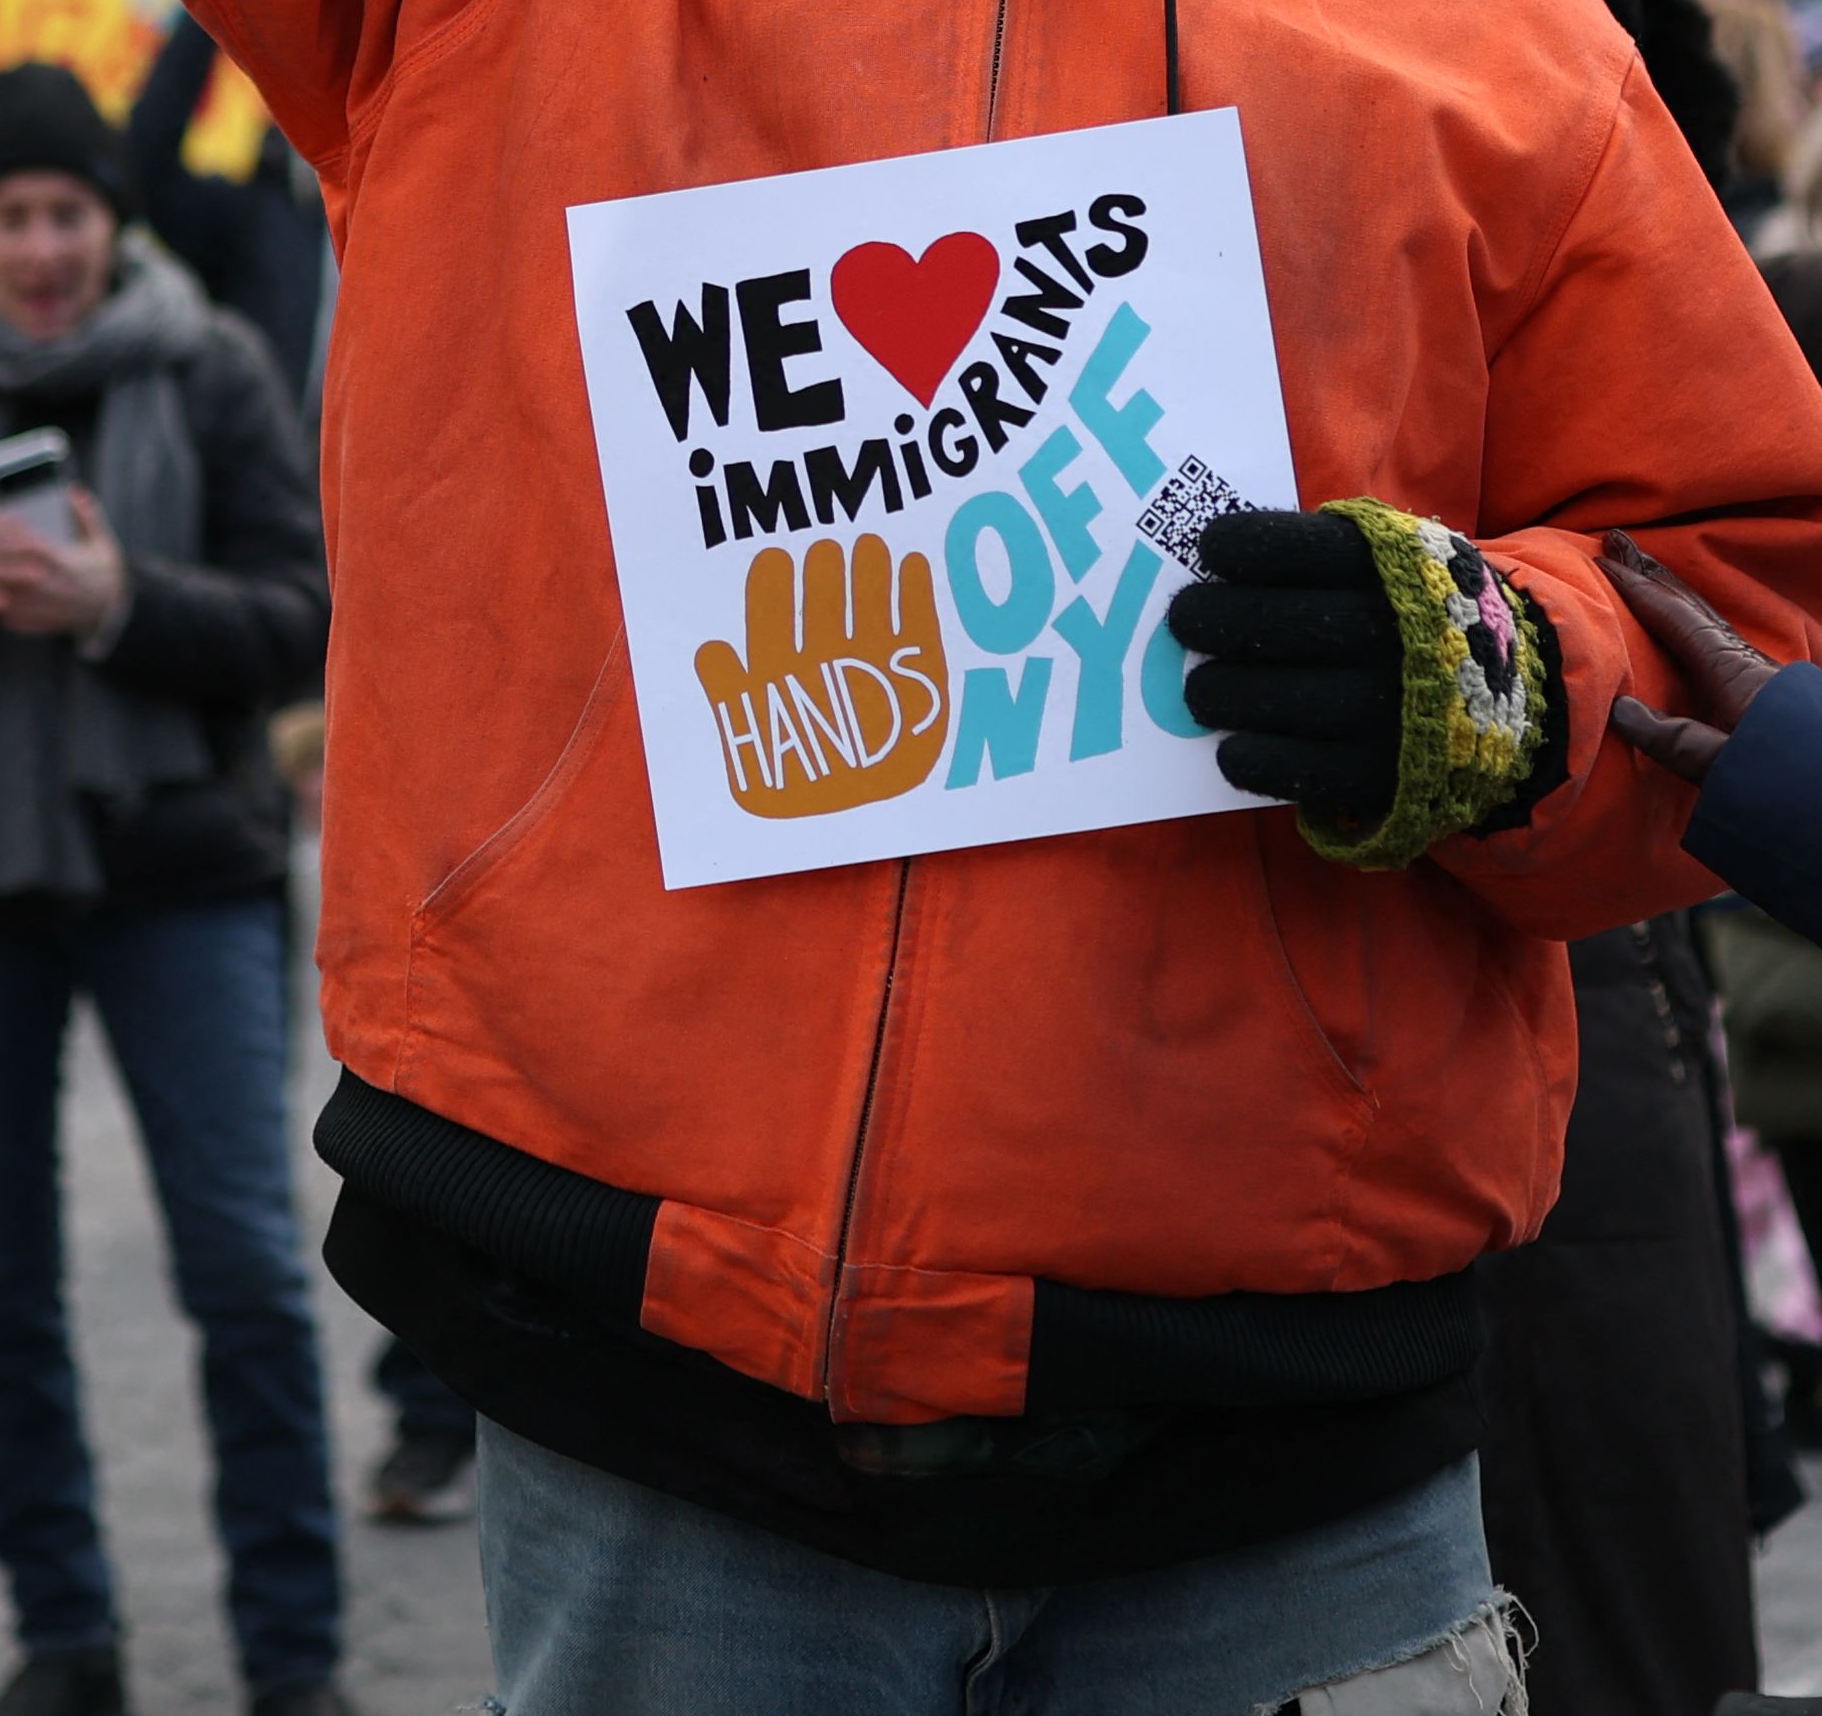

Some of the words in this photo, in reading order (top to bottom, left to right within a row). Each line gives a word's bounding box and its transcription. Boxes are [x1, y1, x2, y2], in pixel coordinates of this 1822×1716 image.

[625, 268, 845, 443] WE
[943, 300, 1168, 656] OFF
[715, 645, 939, 792] HANDS
